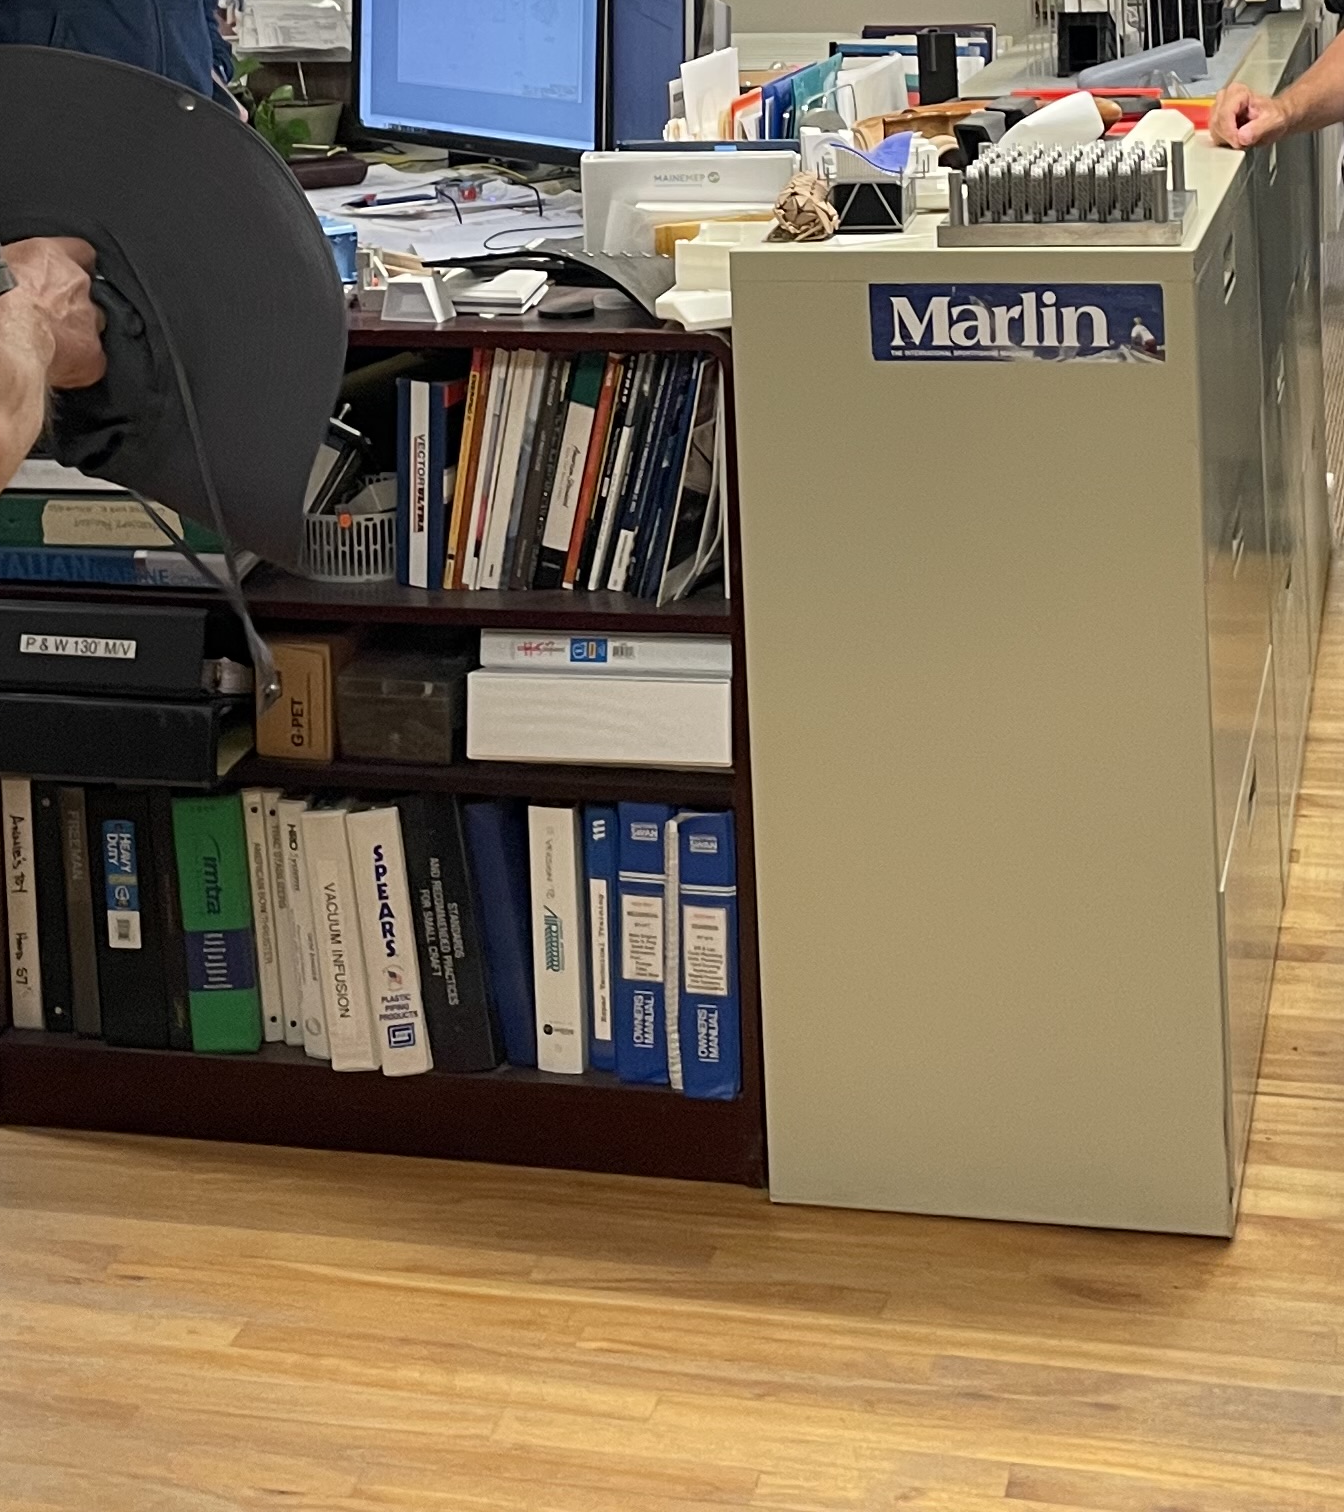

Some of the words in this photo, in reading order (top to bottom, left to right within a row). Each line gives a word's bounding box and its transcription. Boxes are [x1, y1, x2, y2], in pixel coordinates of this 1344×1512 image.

[889, 291, 1110, 347] Marlin
[26, 637, 36, 650] P
[39, 638, 49, 651] &
[54, 639, 69, 653] W
[104, 642, 132, 657] M/V
[291, 697, 304, 747] G-PET
[107, 833, 118, 866] DUTY
[118, 833, 132, 873] HEAVY
[323, 882, 342, 945] VACUUM
[373, 844, 396, 958] SPEARS
[420, 888, 431, 909] FOR
[422, 910, 437, 944] SMALL
[429, 857, 440, 878] AND
[443, 955, 459, 1006] PRACTICES
[332, 950, 351, 1019] INFUSION
[429, 945, 442, 977] CRAFT
[379, 1010, 418, 1022] PRODUCTS
[633, 994, 644, 1044] OWNERS
[643, 992, 654, 1044] MANUAL
[697, 1007, 708, 1059] OWNERS
[707, 1007, 719, 1059] MANUAL
